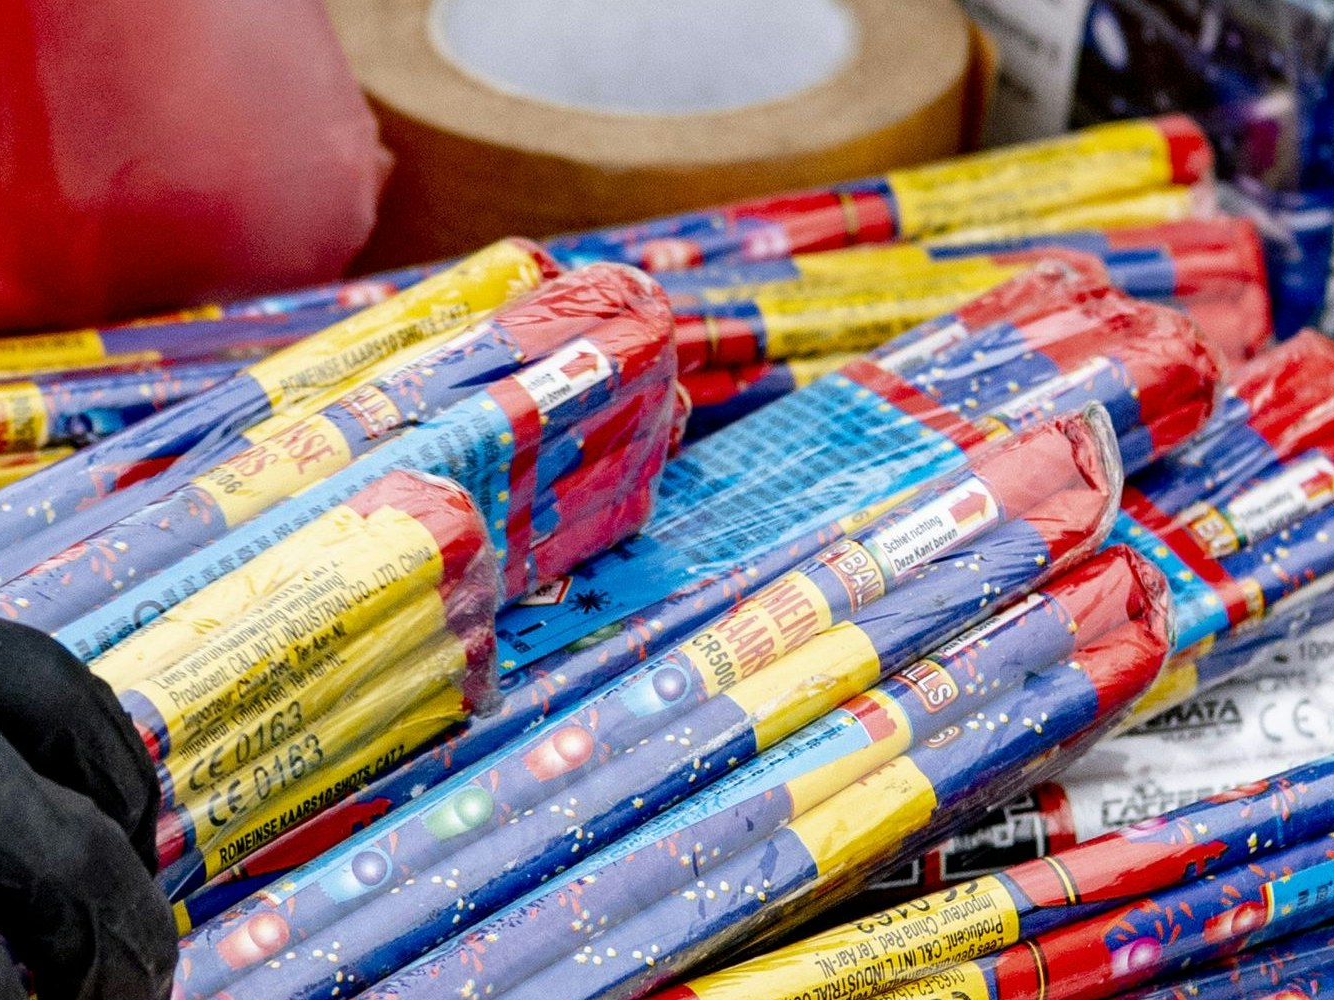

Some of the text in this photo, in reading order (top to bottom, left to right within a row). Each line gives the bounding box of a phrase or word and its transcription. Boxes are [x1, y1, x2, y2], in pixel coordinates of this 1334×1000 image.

[881, 510, 945, 556] Schiet richting
[891, 523, 960, 572] Deze Kant boven
[169, 660, 232, 711] Producent:
[227, 648, 258, 676] C&L
[279, 588, 354, 646] INDUSTRIAL
[691, 627, 743, 692] CR500
[180, 698, 309, 793] CE 0163
[1258, 697, 1316, 745] CE
[198, 731, 330, 830] CE 0163
[213, 814, 282, 866] ROMEINSE
[814, 891, 996, 981] Importeur: China Red, Ter Aar-NL
[916, 939, 944, 963] C&L
[940, 914, 1004, 953] Producent:
